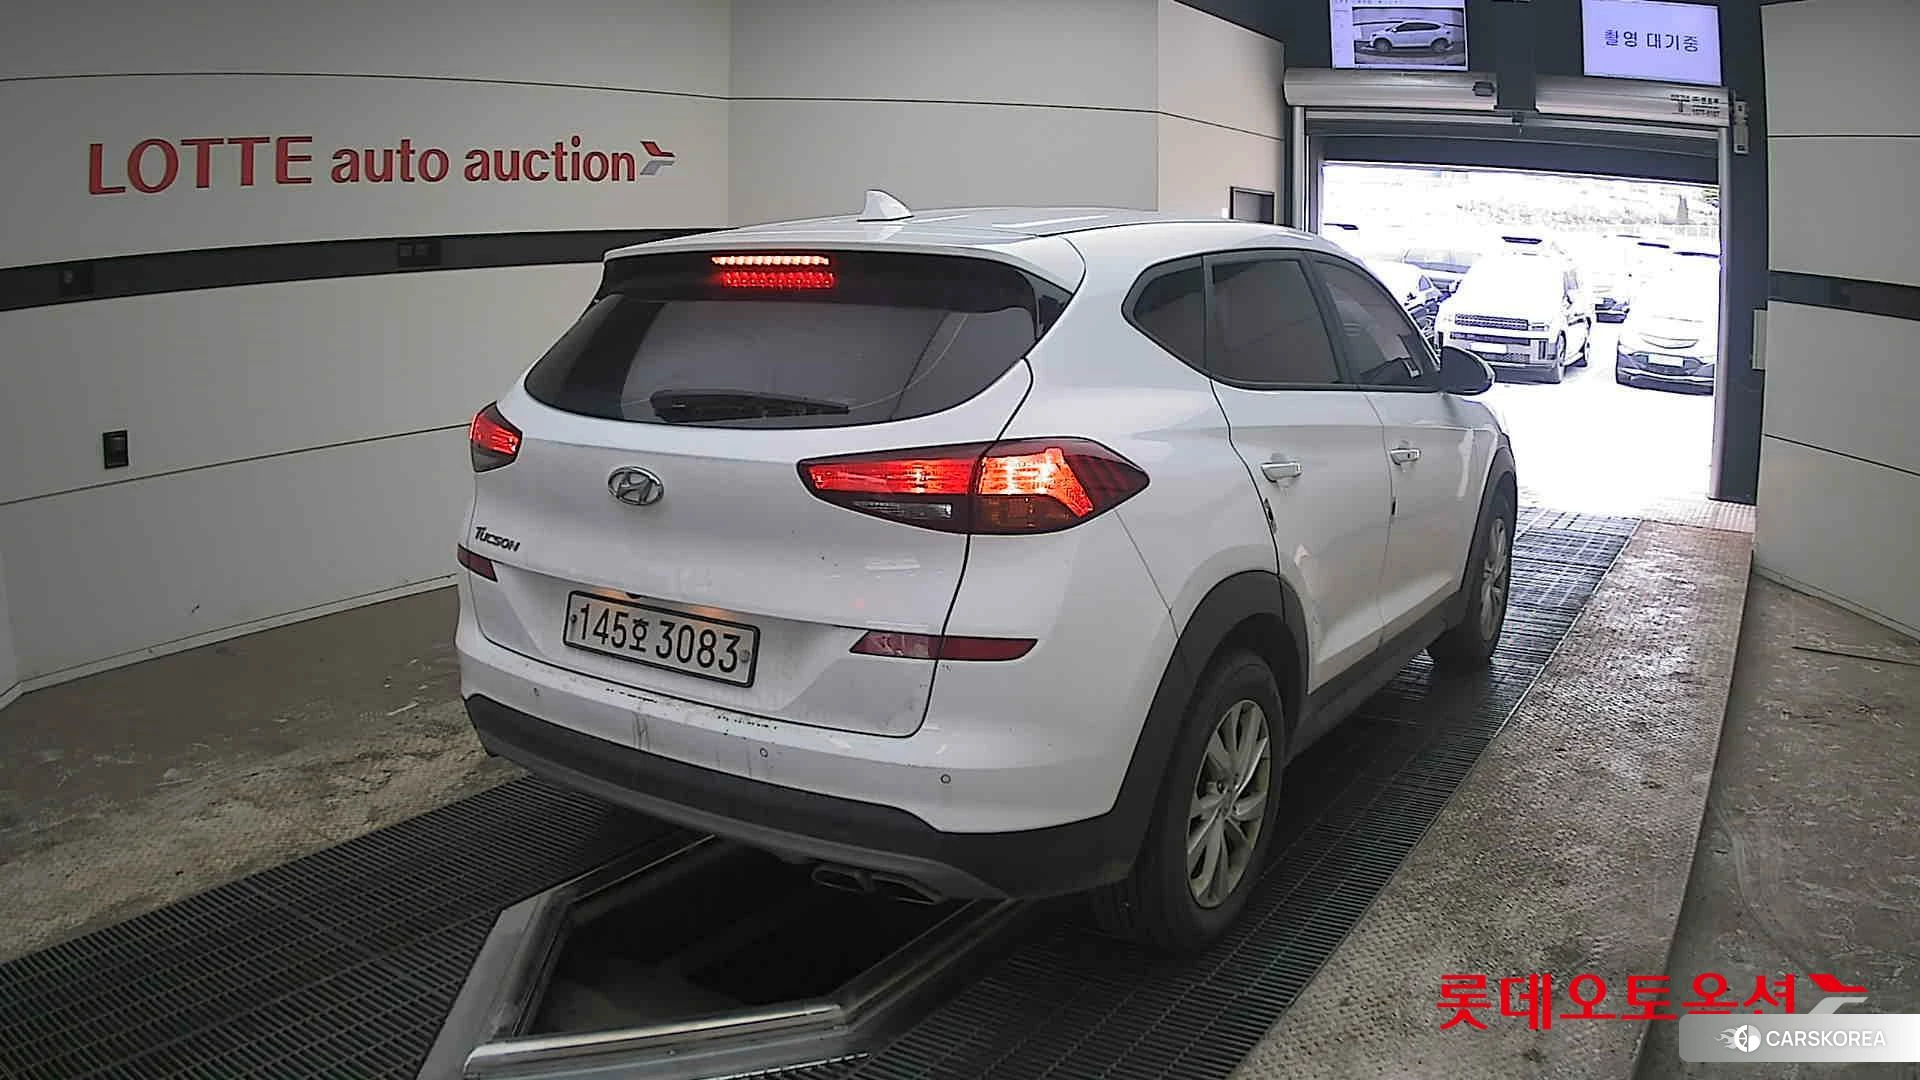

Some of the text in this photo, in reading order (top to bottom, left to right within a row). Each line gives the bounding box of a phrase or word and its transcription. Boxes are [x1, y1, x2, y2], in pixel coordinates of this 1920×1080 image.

[1646, 32, 1698, 52] 대기중
[89, 135, 636, 195] LOTTE auto auction
[580, 603, 741, 673] 145호 3083
